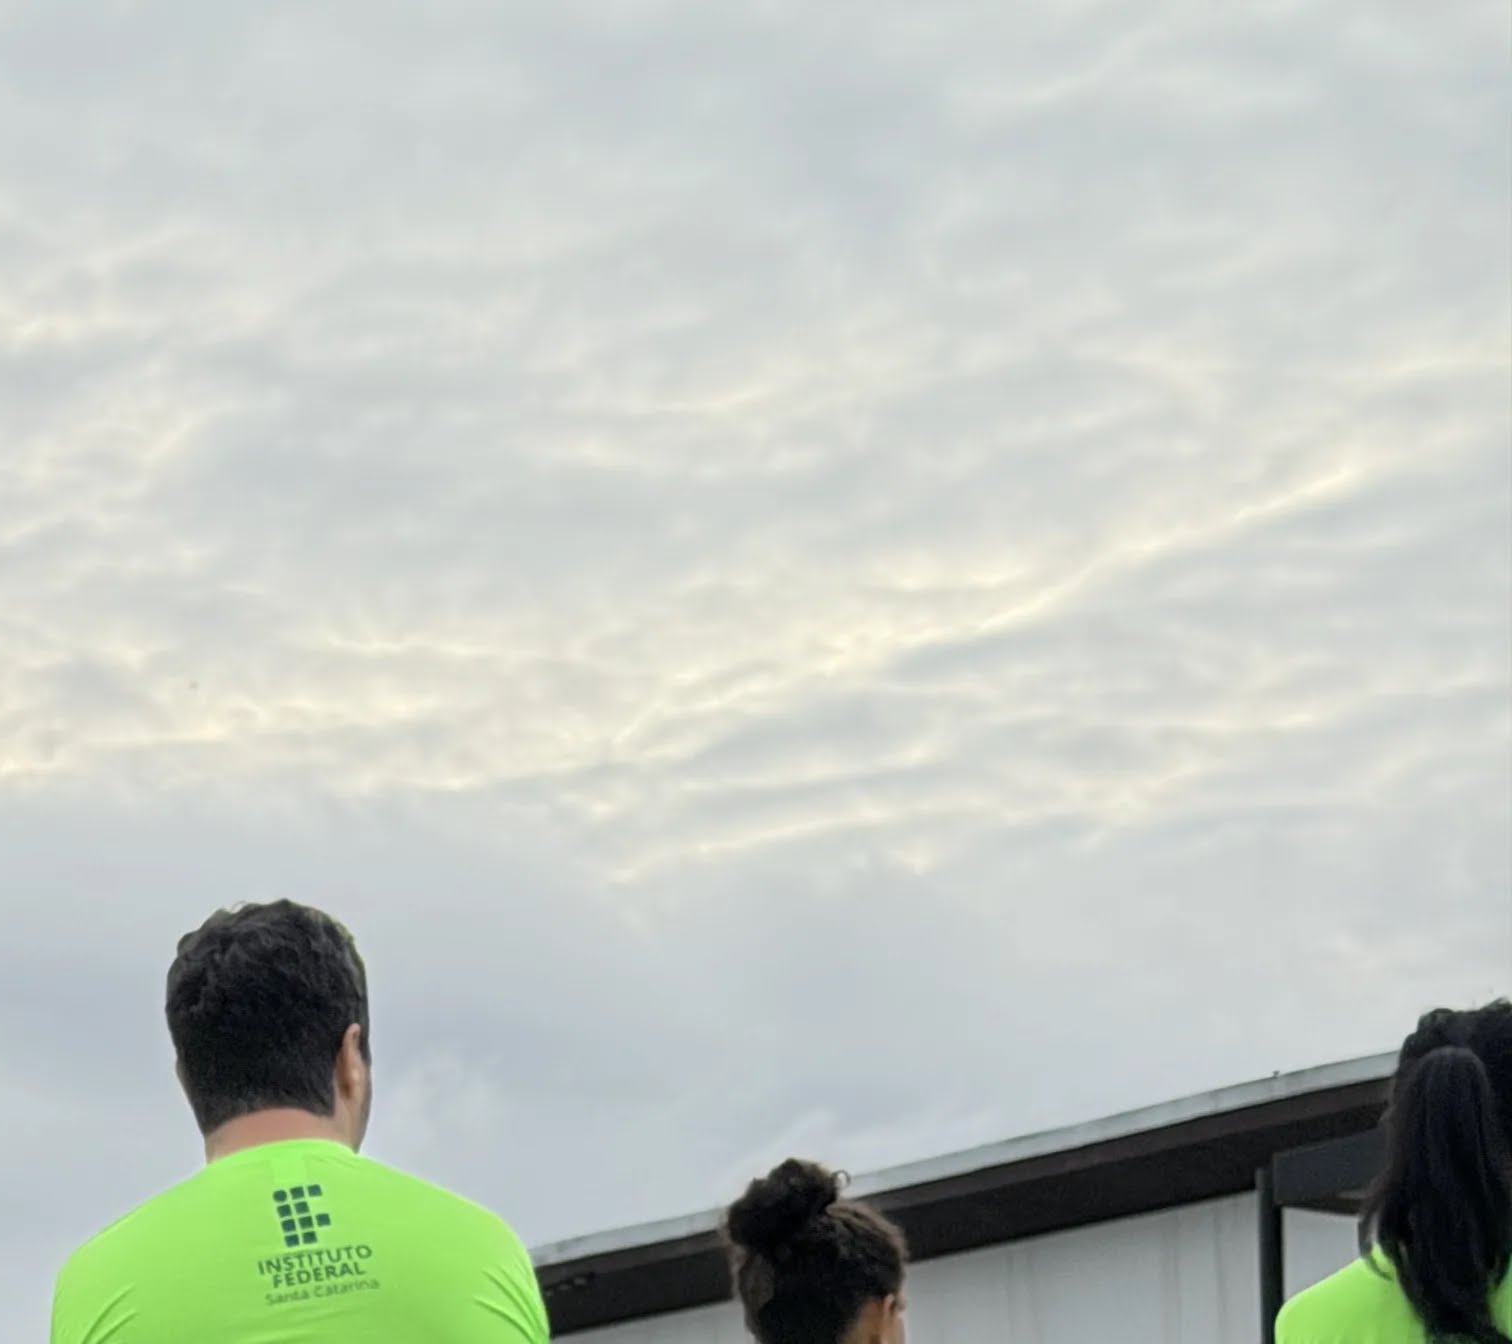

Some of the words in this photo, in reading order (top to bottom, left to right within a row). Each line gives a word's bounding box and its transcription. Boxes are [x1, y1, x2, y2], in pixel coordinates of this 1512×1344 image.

[257, 1245, 372, 1275] INSTITUTO
[273, 1262, 367, 1289] FEDERAL
[265, 1290, 310, 1306] Santa
[313, 1279, 381, 1299] Catarina
